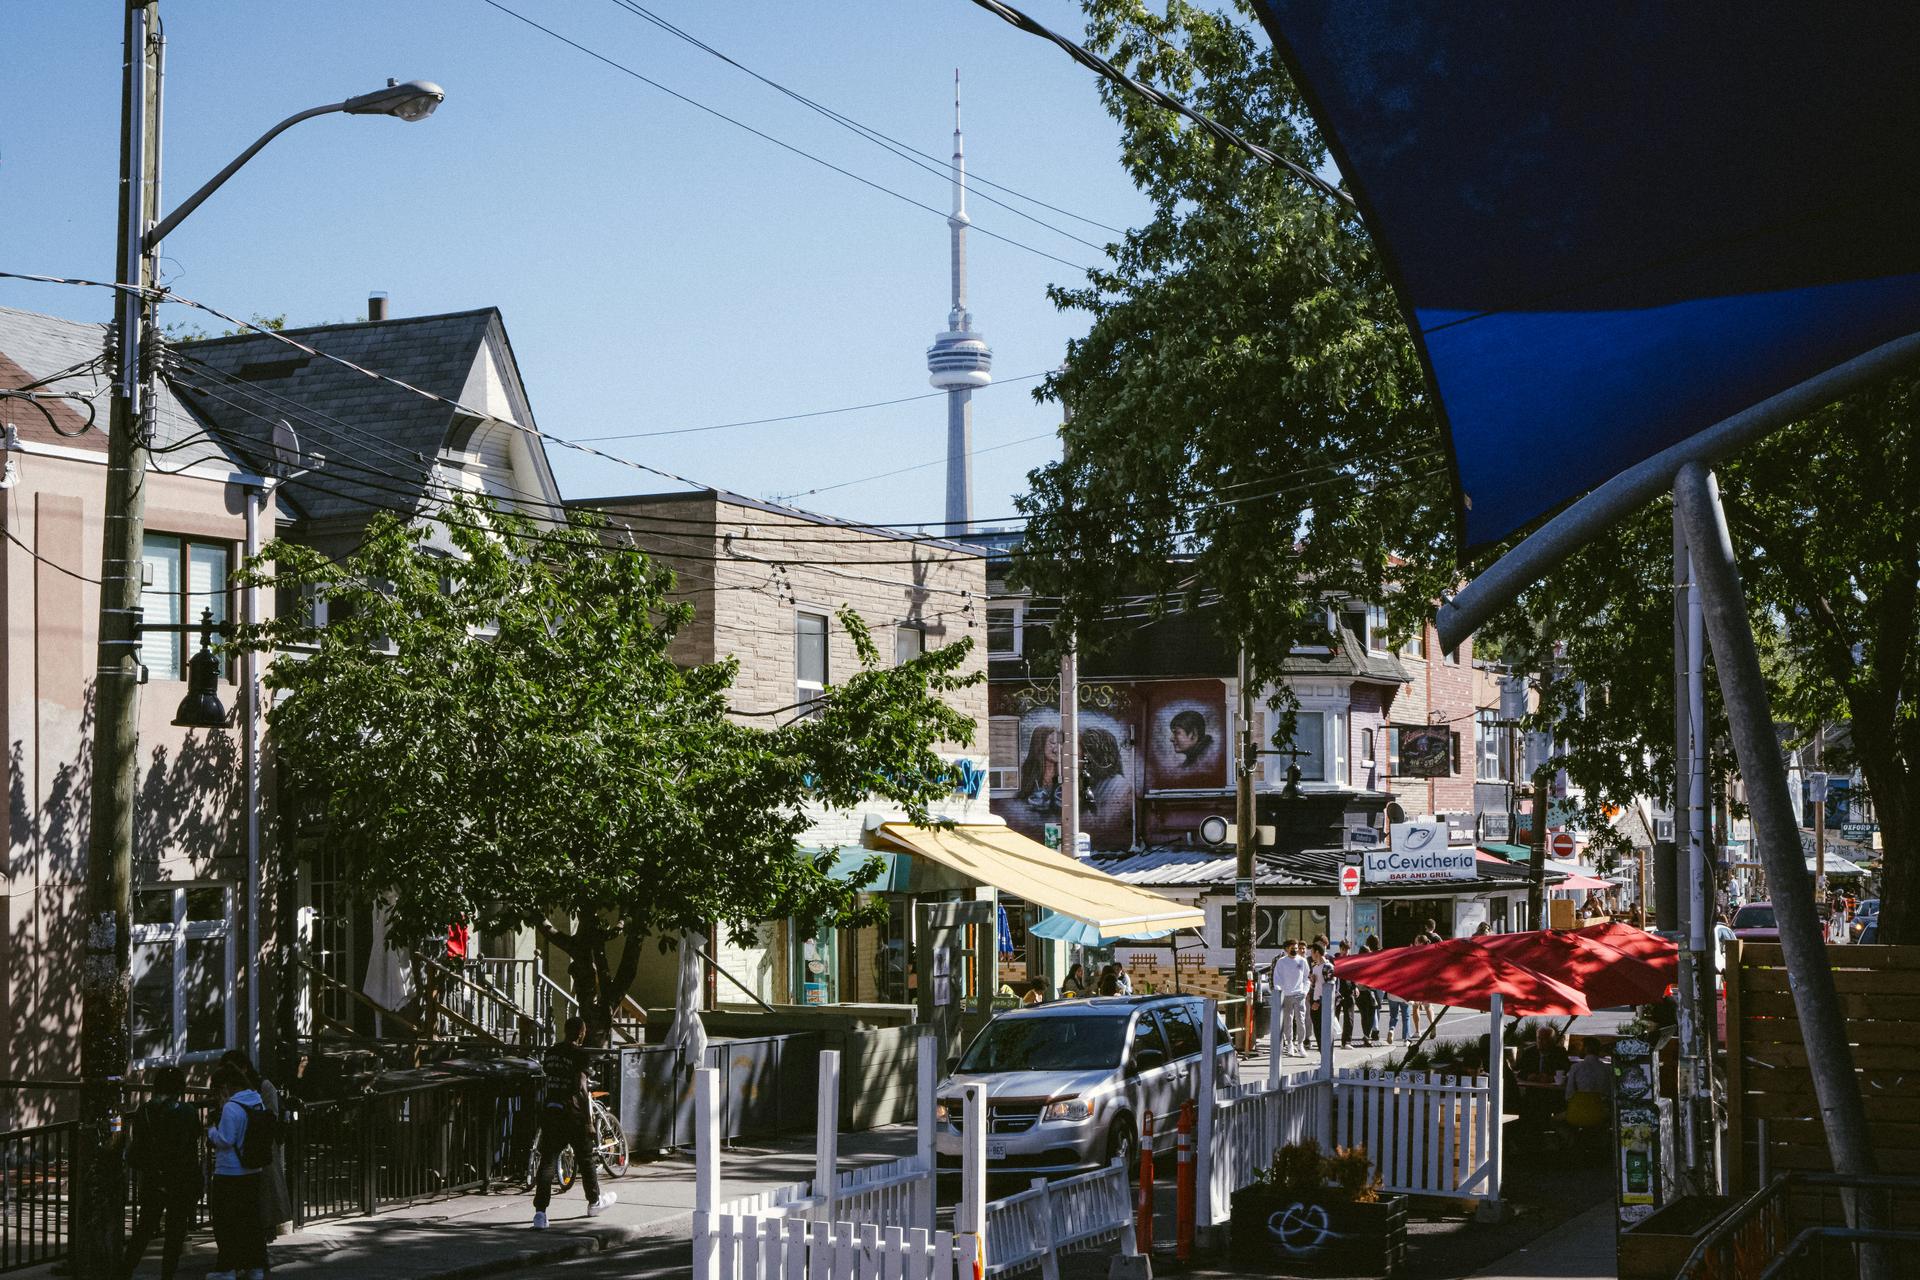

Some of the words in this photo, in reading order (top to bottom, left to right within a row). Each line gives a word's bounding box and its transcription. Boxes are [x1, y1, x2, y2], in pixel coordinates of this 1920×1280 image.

[1013, 685, 1114, 709] ROMO'S
[961, 758, 987, 800] Sky
[1368, 855, 1386, 870] La
[1388, 852, 1473, 869] Cevichería
